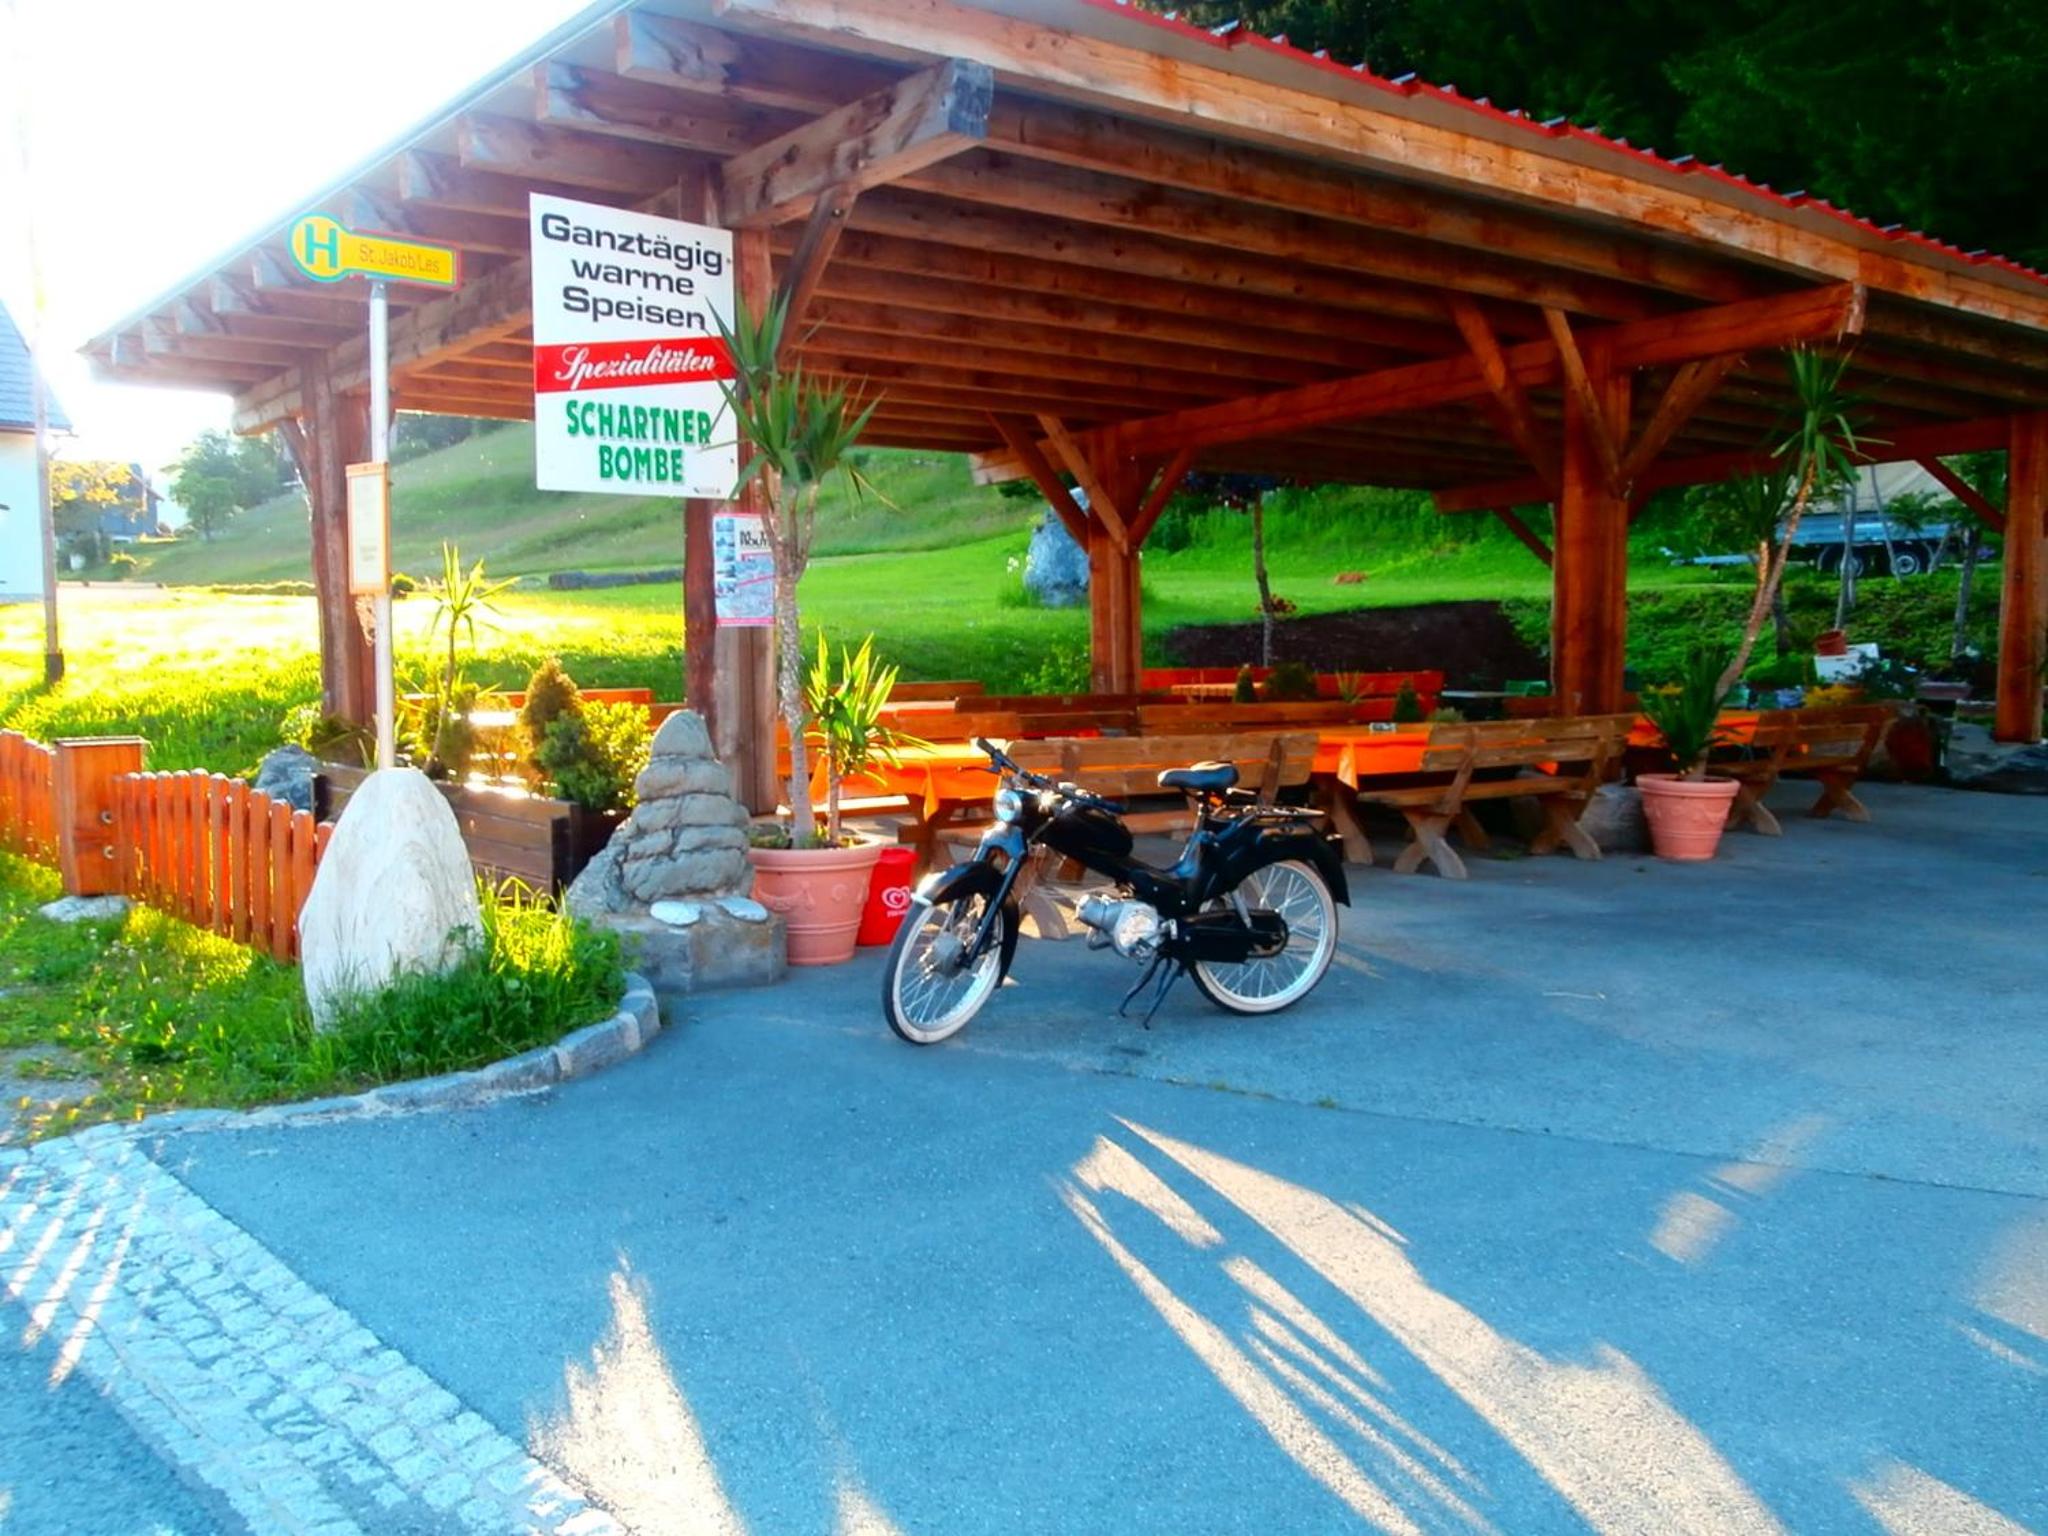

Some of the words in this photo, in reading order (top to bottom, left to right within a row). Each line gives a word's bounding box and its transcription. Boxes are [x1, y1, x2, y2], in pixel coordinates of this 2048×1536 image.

[305, 223, 338, 269] H
[541, 213, 722, 276] Ganztägig
[571, 258, 695, 296] warme
[562, 285, 706, 331] Speisen
[555, 343, 717, 391] Spezialitäten
[566, 399, 712, 444] SCHARTNER
[598, 445, 685, 483] BOMBE
